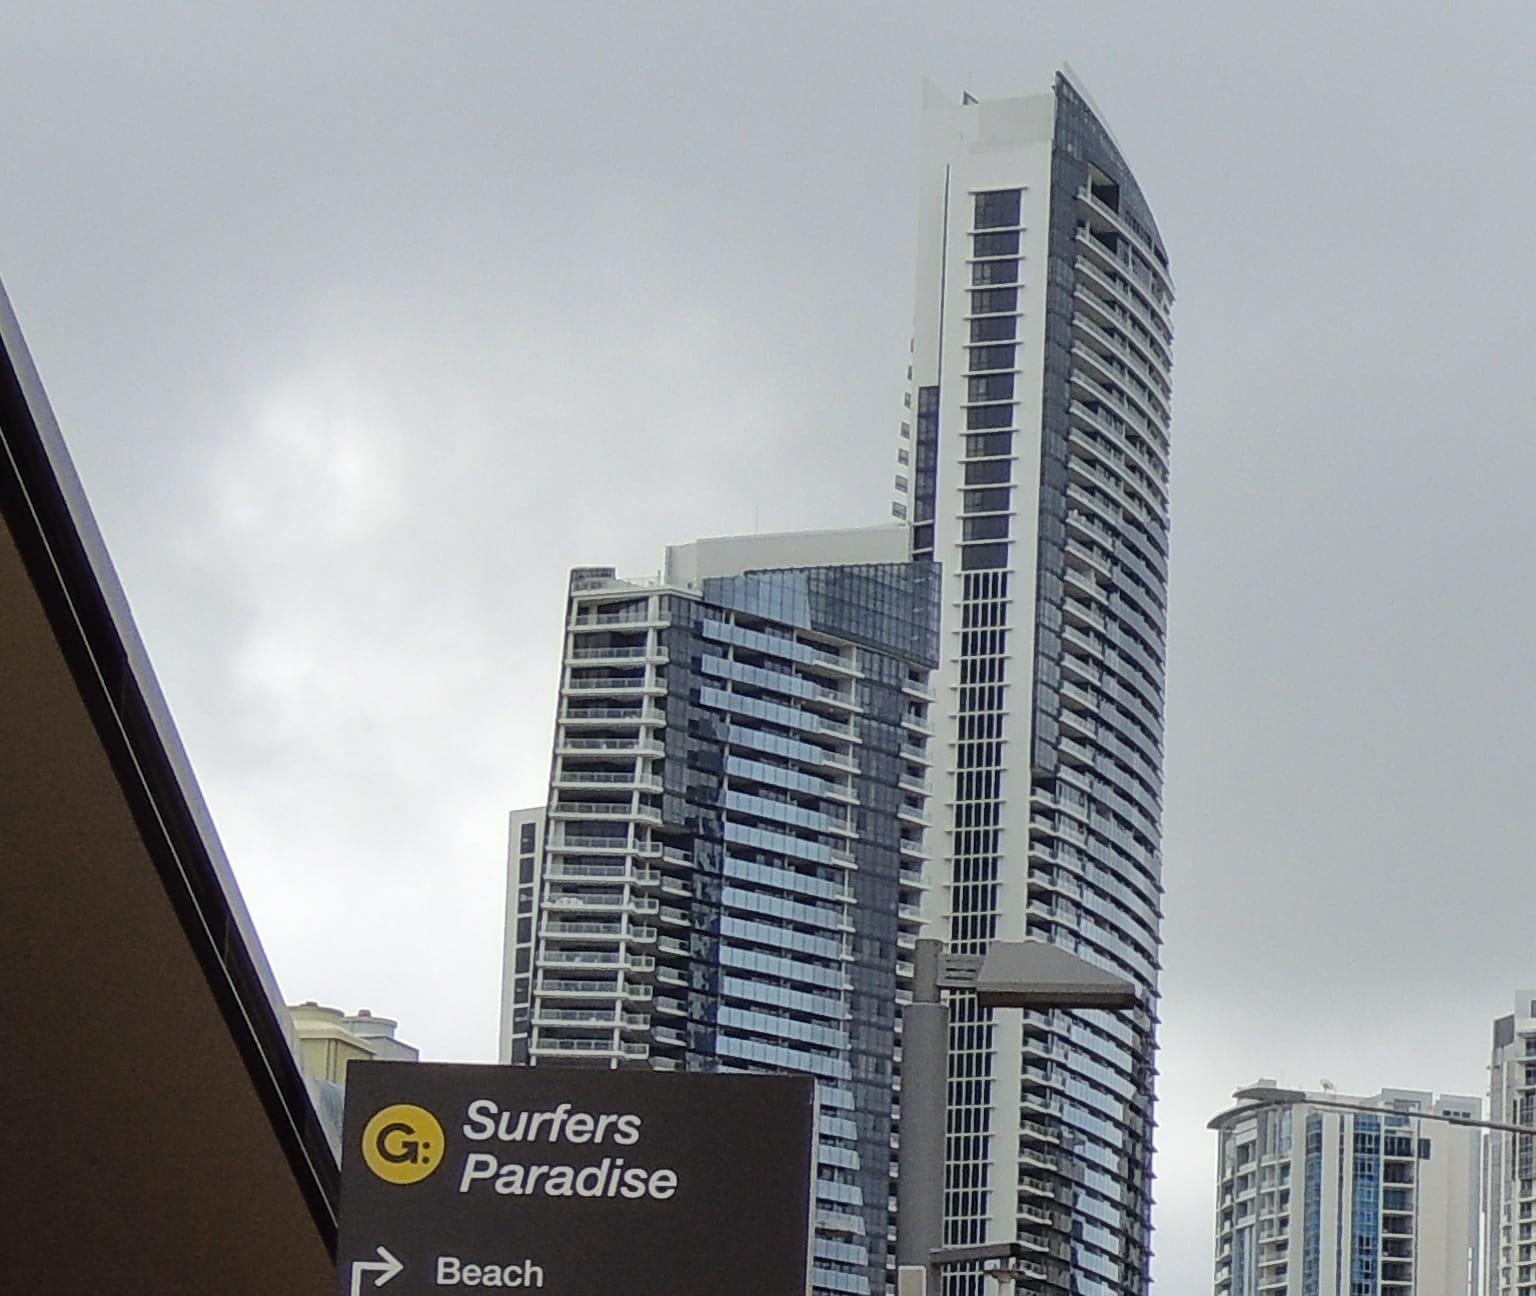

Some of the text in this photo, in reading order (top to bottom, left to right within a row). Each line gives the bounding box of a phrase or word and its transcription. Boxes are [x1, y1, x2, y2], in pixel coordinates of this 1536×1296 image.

[462, 1099, 642, 1145] Surfers
[459, 1153, 679, 1200] Paradise
[436, 1256, 544, 1288] Beach
